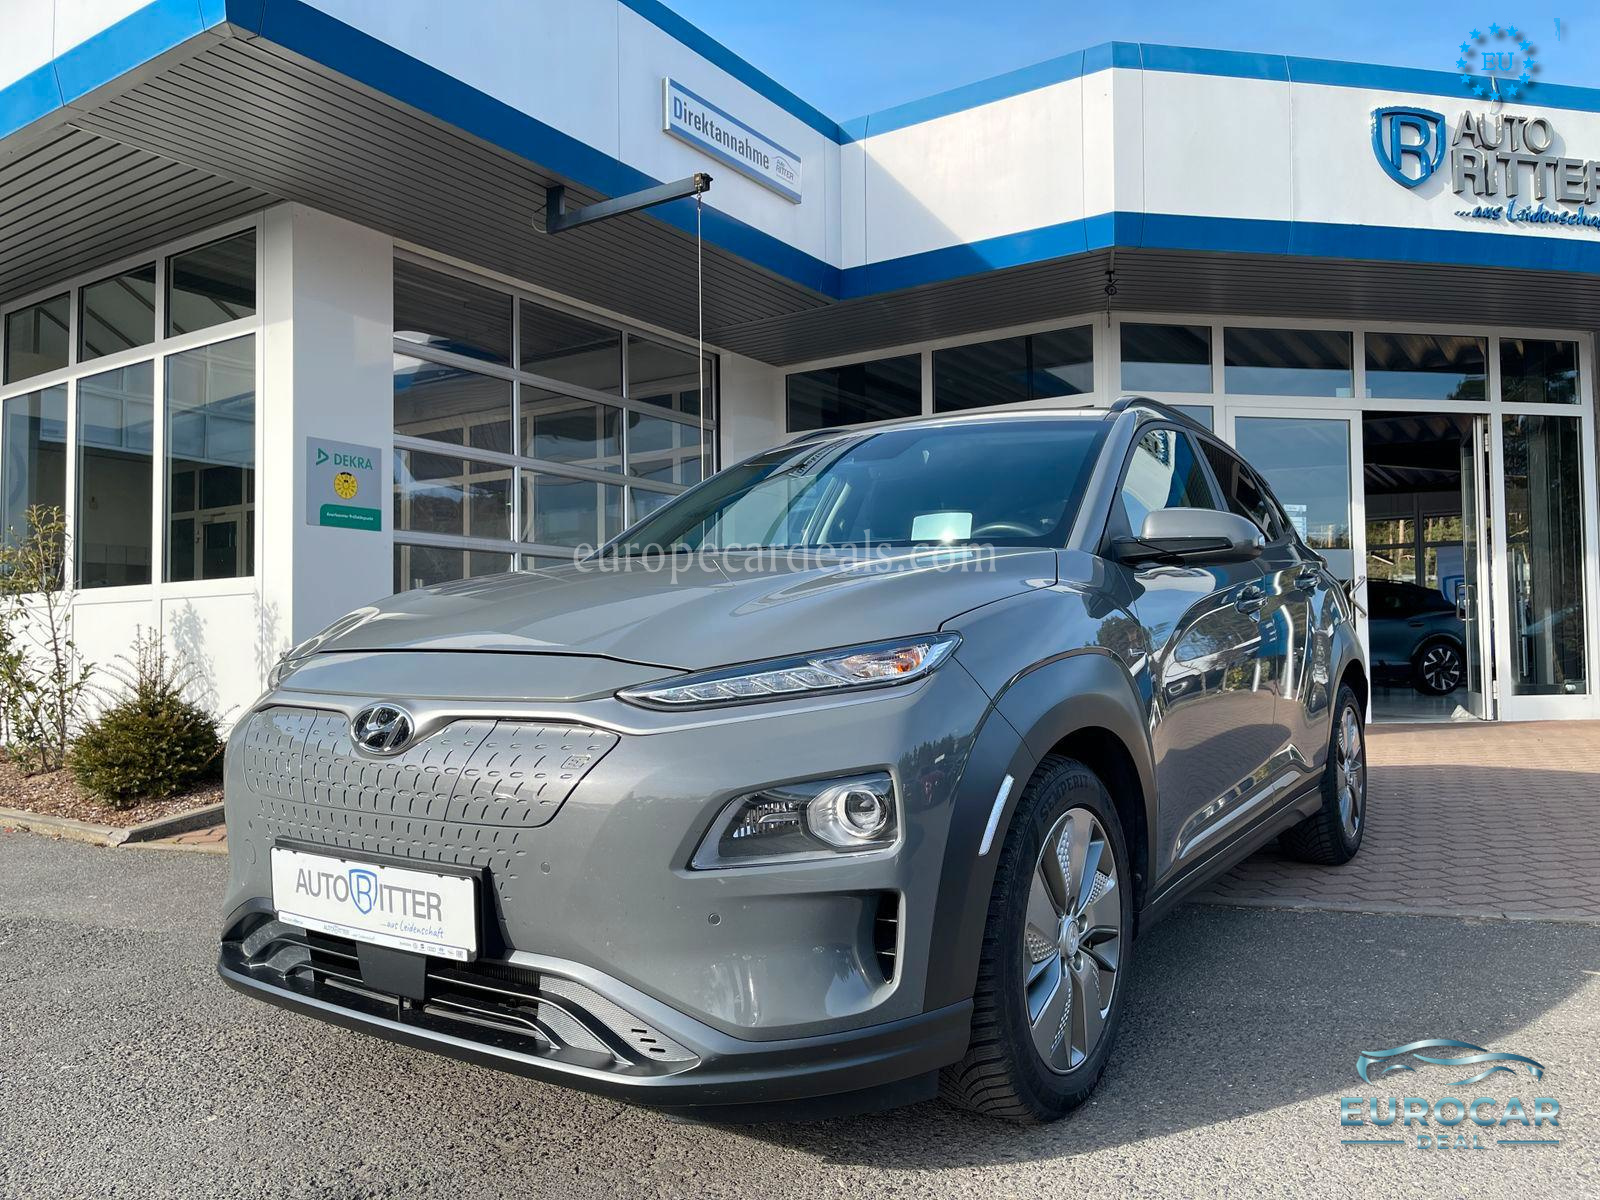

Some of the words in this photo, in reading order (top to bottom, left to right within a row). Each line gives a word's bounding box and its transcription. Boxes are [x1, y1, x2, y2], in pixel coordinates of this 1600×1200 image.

[673, 95, 770, 170] Direktannahme
[1452, 110, 1555, 154] AUTO
[334, 453, 373, 470] DEKRA
